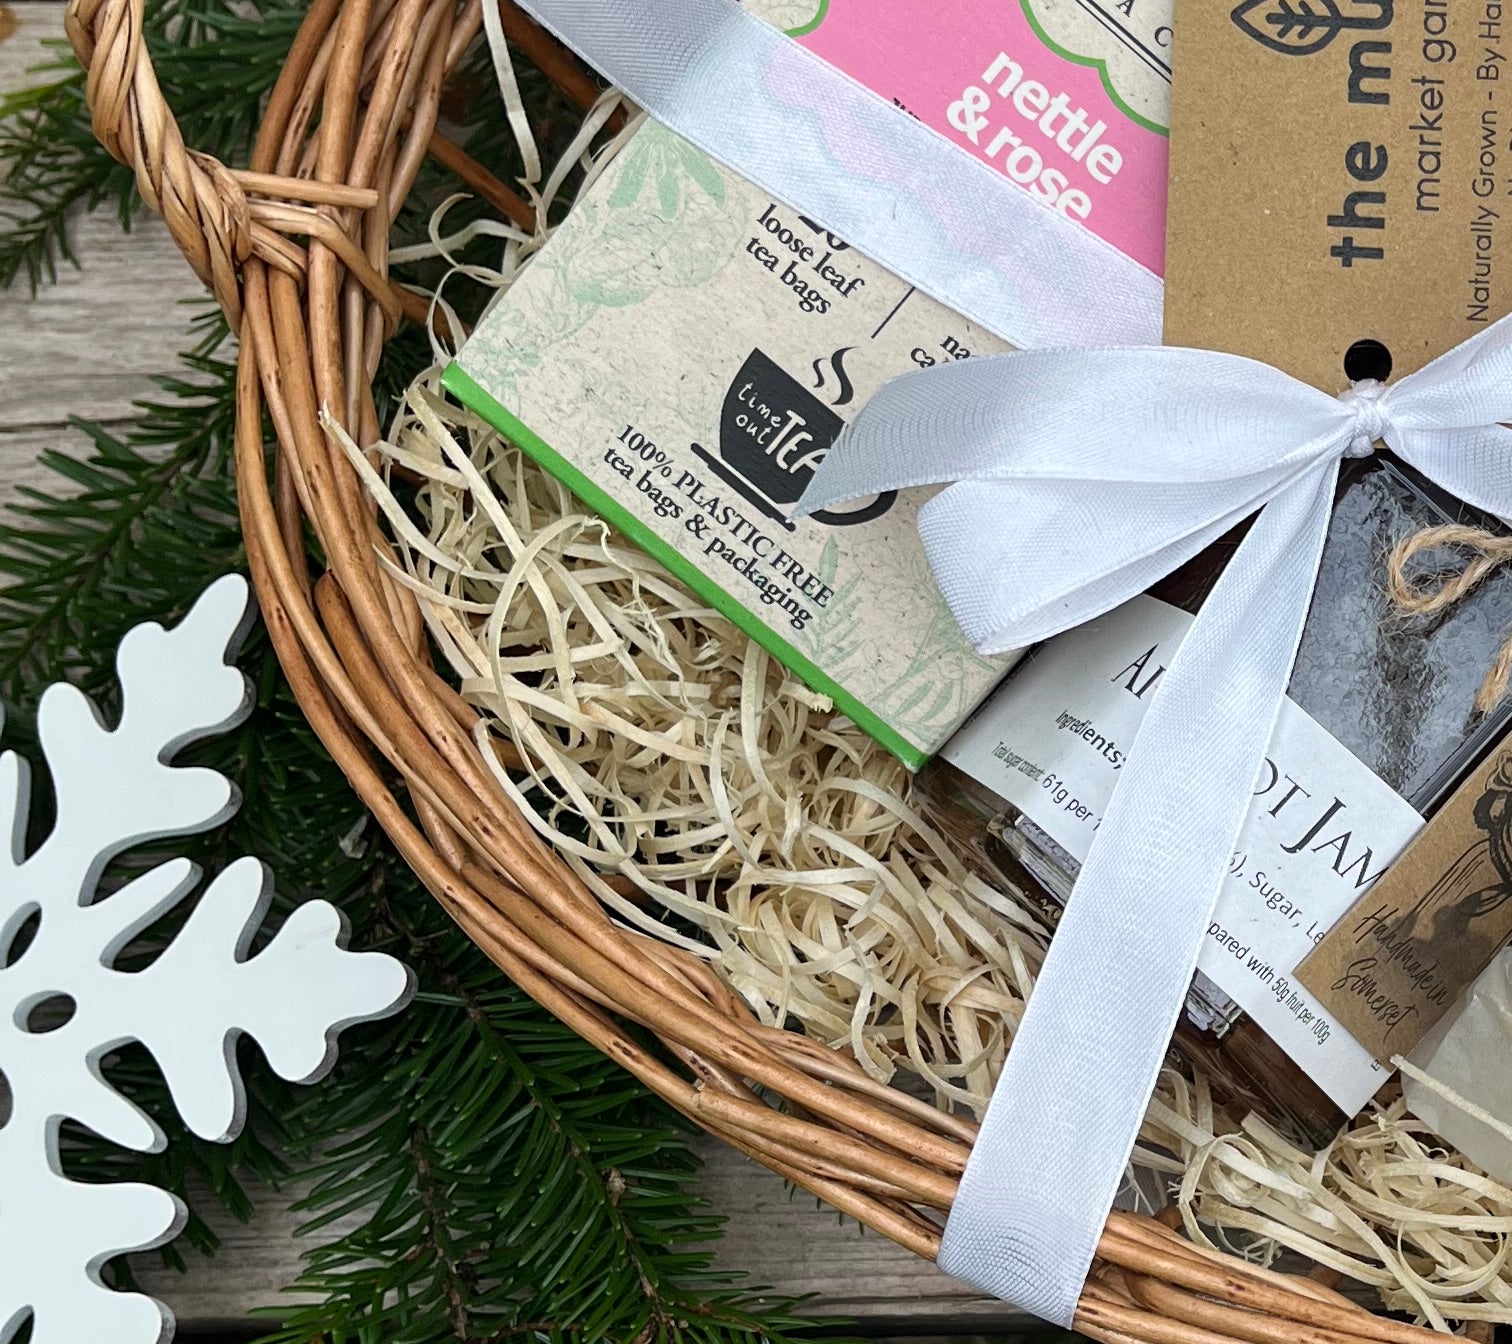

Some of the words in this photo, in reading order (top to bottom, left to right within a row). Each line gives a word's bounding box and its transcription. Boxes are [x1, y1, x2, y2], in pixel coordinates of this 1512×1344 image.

[1477, 48, 1507, 81] By
[946, 85, 991, 146] &
[984, 126, 1092, 223] rose
[981, 51, 1123, 185] nettle
[1409, 76, 1445, 212] market
[1472, 110, 1497, 197] Grown
[756, 203, 814, 262] loose
[812, 251, 865, 298] leaf
[1326, 141, 1388, 268] the
[746, 237, 780, 272] tea
[780, 261, 831, 314] bags
[1467, 205, 1499, 321] Naturally
[735, 414, 771, 445] out
[765, 409, 832, 474] TEA
[738, 382, 782, 427] time
[604, 447, 634, 481] tea
[636, 470, 684, 519] bags
[685, 515, 711, 541] &
[703, 536, 813, 630] packaging
[617, 424, 674, 478] 100%
[672, 470, 774, 557] PLASTIC
[770, 549, 835, 608] FREE
[1042, 773, 1069, 804] 61g
[1064, 798, 1093, 822] per
[1206, 920, 1251, 960] pared
[1247, 952, 1274, 984] with
[1271, 977, 1289, 1002] 50g
[1285, 991, 1304, 1015] fruit
[1297, 1006, 1314, 1026] per
[1311, 1018, 1331, 1045] 100g
[1249, 871, 1303, 928] Sugar,
[1353, 904, 1434, 991] Handmade
[1331, 957, 1419, 1044] Somerset
